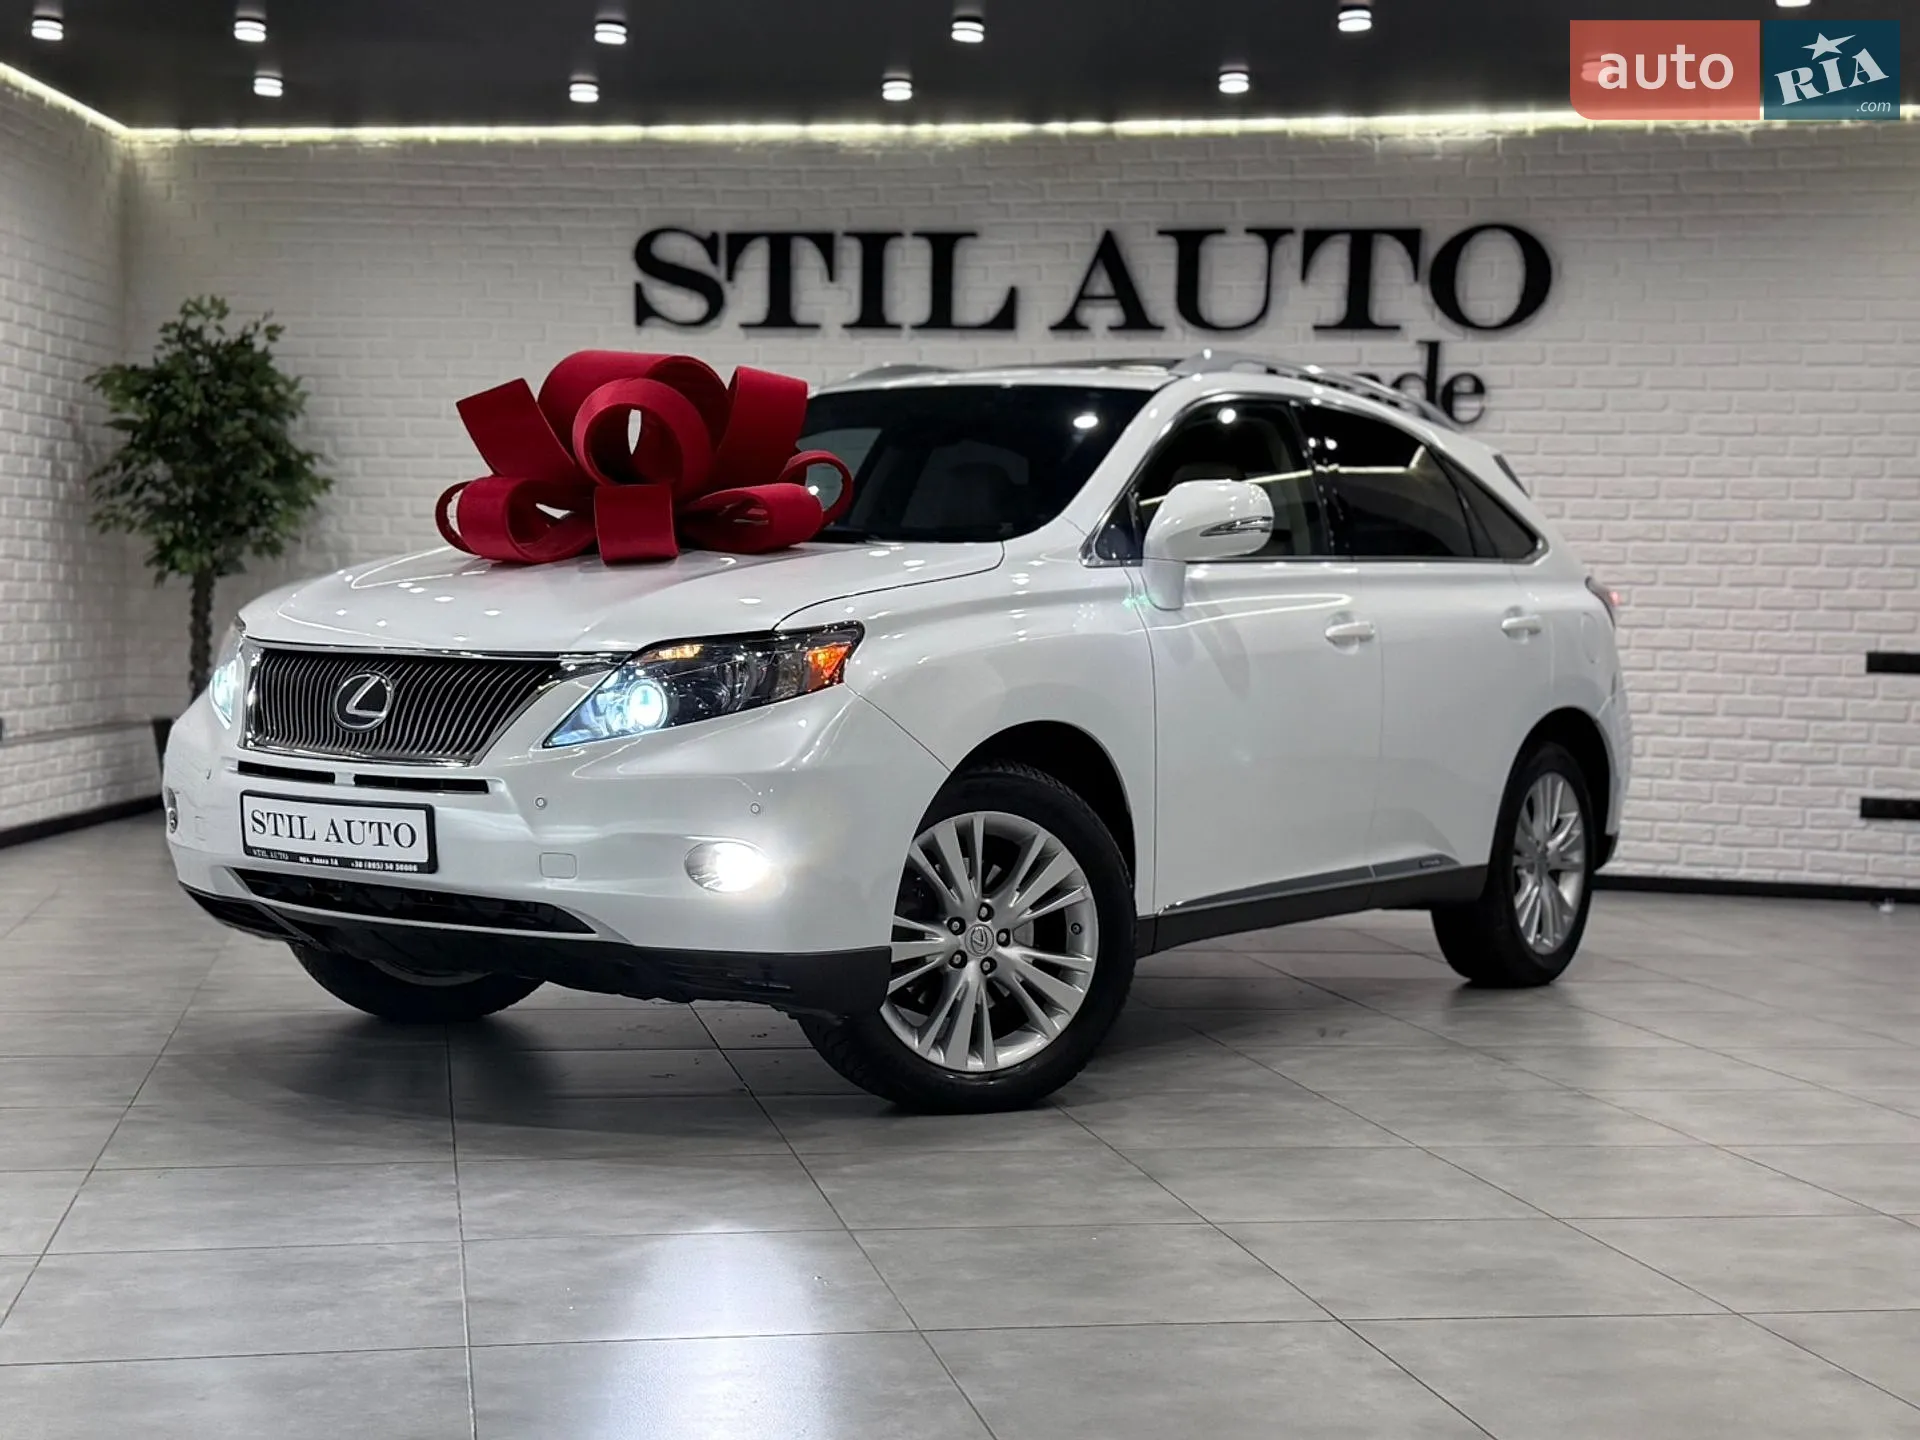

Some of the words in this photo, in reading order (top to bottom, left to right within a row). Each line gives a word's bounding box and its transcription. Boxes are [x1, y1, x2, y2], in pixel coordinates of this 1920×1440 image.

[634, 227, 1018, 331] STIL
[1049, 224, 1553, 331] AUTO
[250, 809, 316, 841] STIL
[324, 818, 417, 848] AUTO
